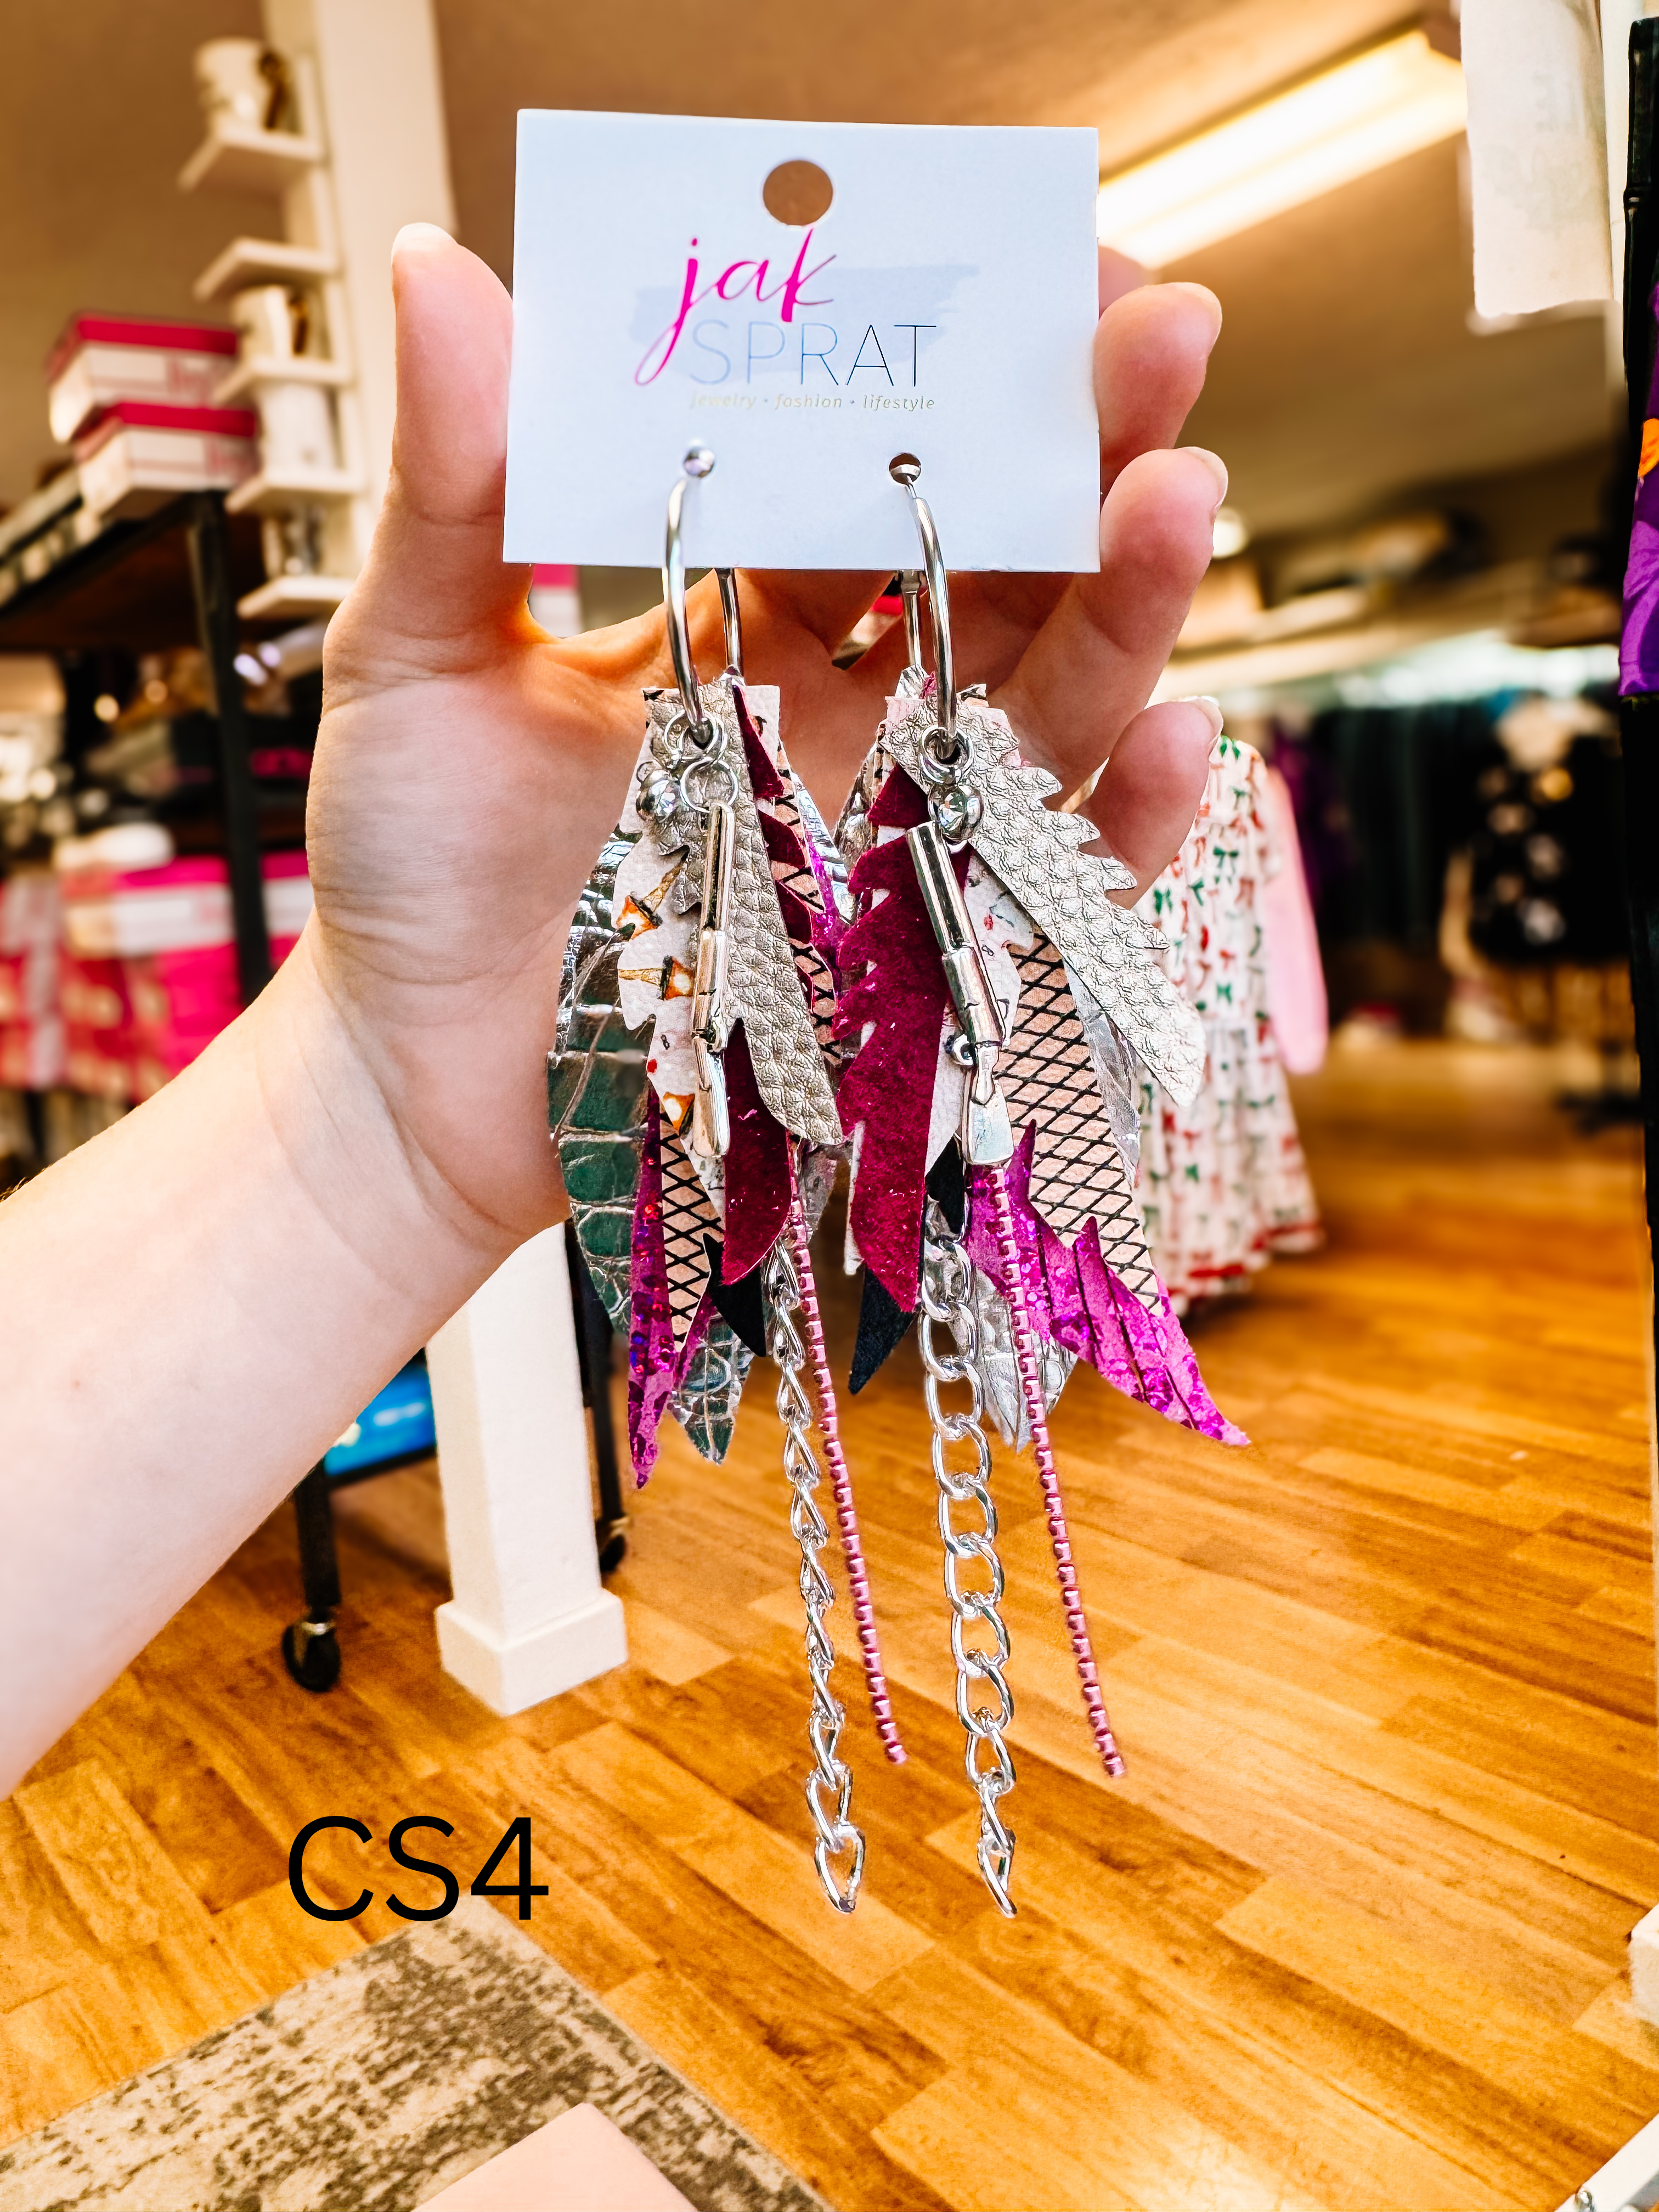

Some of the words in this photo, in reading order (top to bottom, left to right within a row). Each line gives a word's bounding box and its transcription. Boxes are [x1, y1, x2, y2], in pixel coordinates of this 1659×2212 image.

[635, 227, 837, 386] jak
[690, 318, 937, 386] SPRAT
[774, 393, 843, 410] fashion
[862, 394, 935, 412] lifestyle
